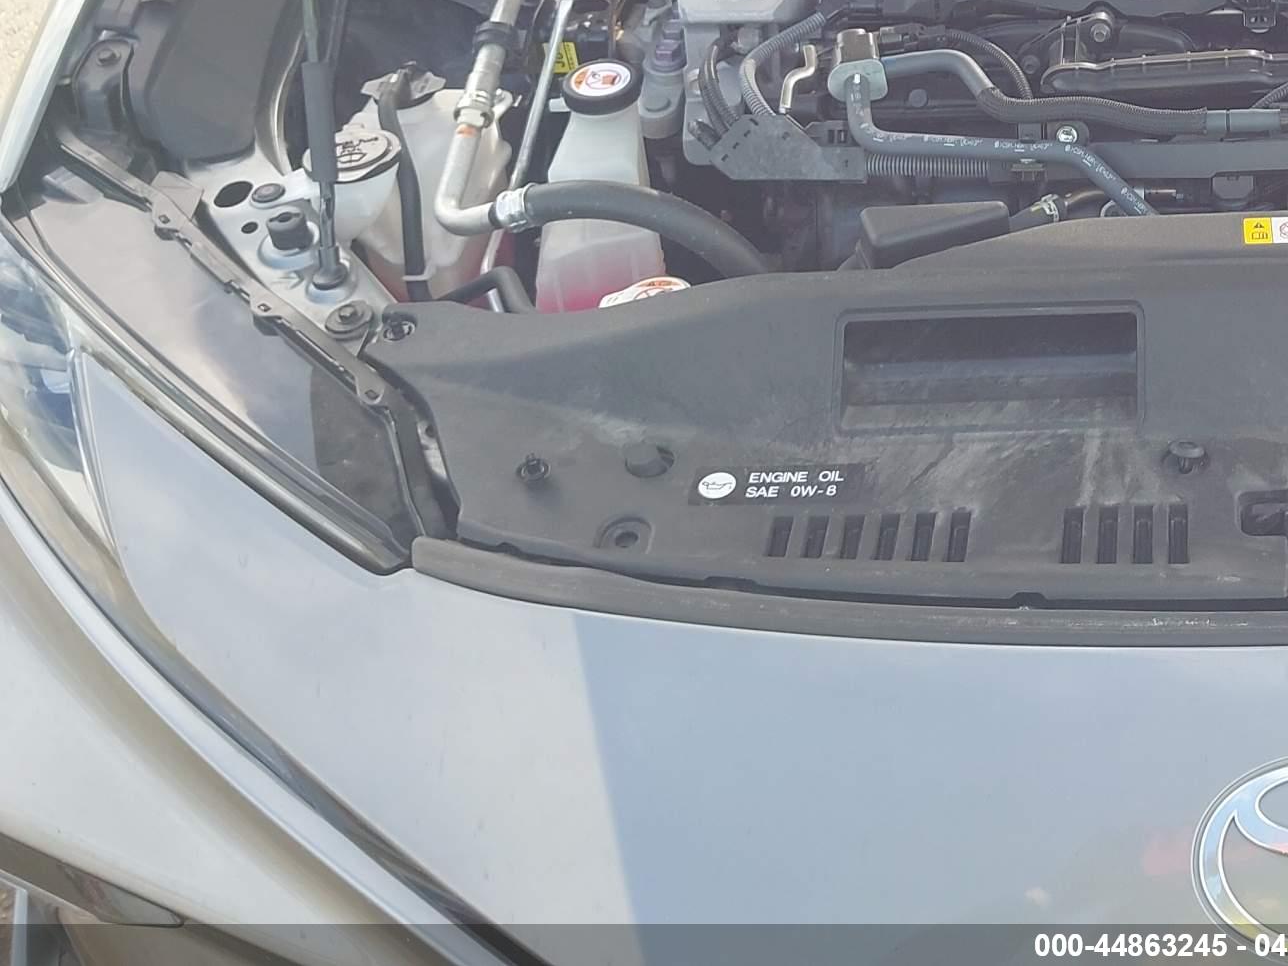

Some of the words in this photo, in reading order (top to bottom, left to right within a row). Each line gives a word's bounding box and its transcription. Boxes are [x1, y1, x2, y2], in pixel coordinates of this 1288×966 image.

[748, 471, 809, 484] ENGINE
[818, 470, 844, 483] OIL
[745, 485, 780, 498] SAE
[790, 484, 837, 498] 0W-8
